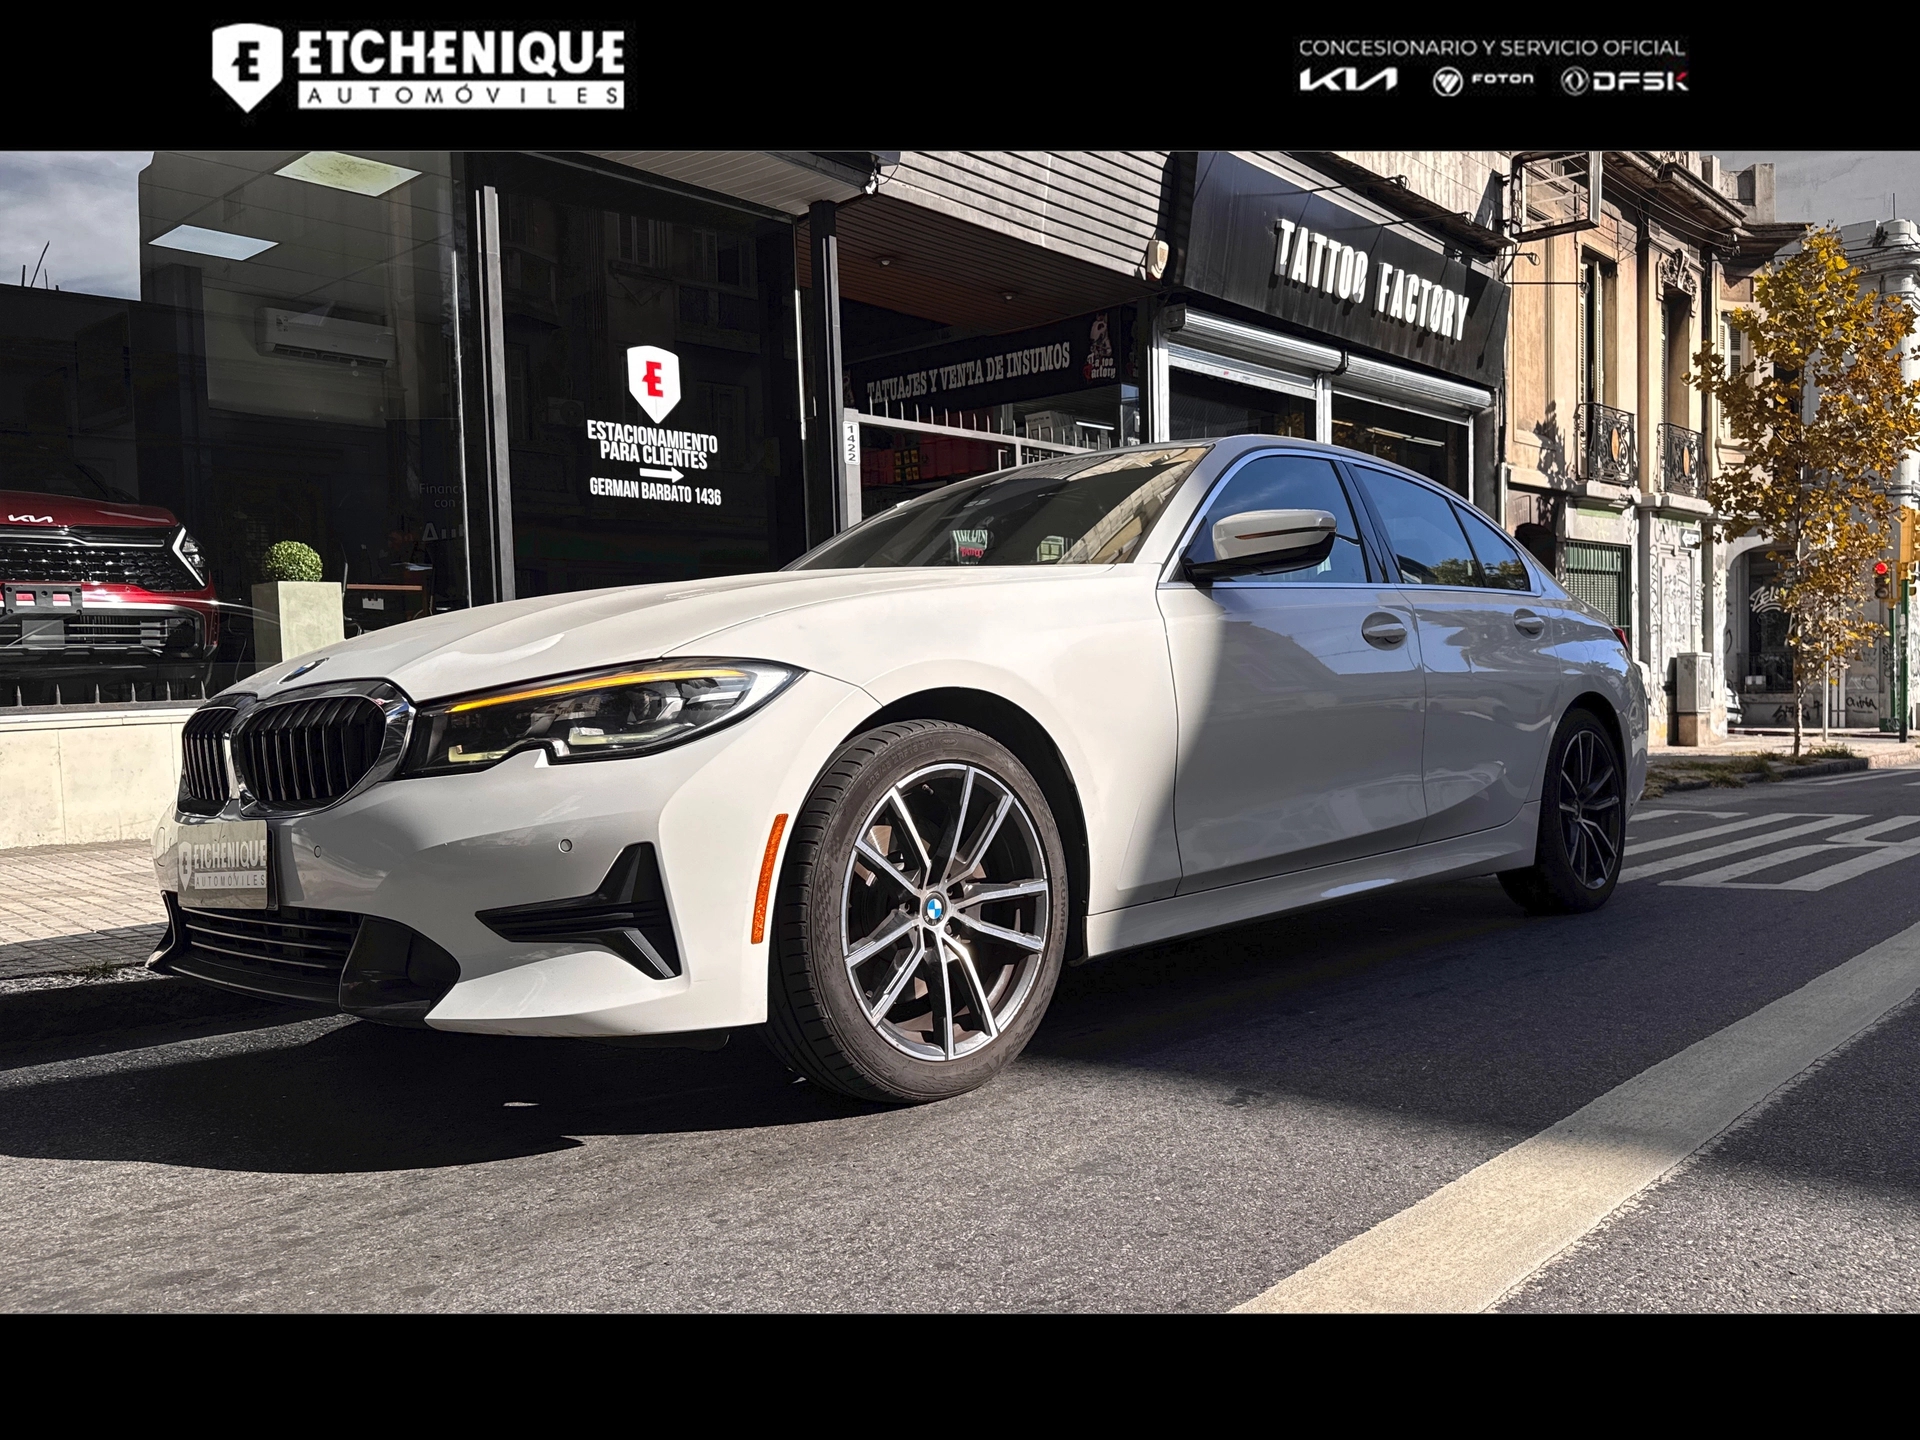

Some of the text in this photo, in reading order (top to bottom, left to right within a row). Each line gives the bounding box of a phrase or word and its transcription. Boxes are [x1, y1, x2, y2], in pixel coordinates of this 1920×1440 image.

[1274, 218, 1470, 341] TATTOO FACTORY
[867, 341, 1071, 404] TATUAJES Y VENTA DE INSUMOS
[587, 419, 718, 454] ESTACIONAMIENTO
[846, 425, 857, 462] 1422
[600, 440, 708, 470] PARA CLIENTES
[590, 477, 722, 506] GERMAN BARBATO 1436
[193, 840, 267, 869] ETCHENIQUE
[195, 873, 266, 887] AUTOMÓVILES
